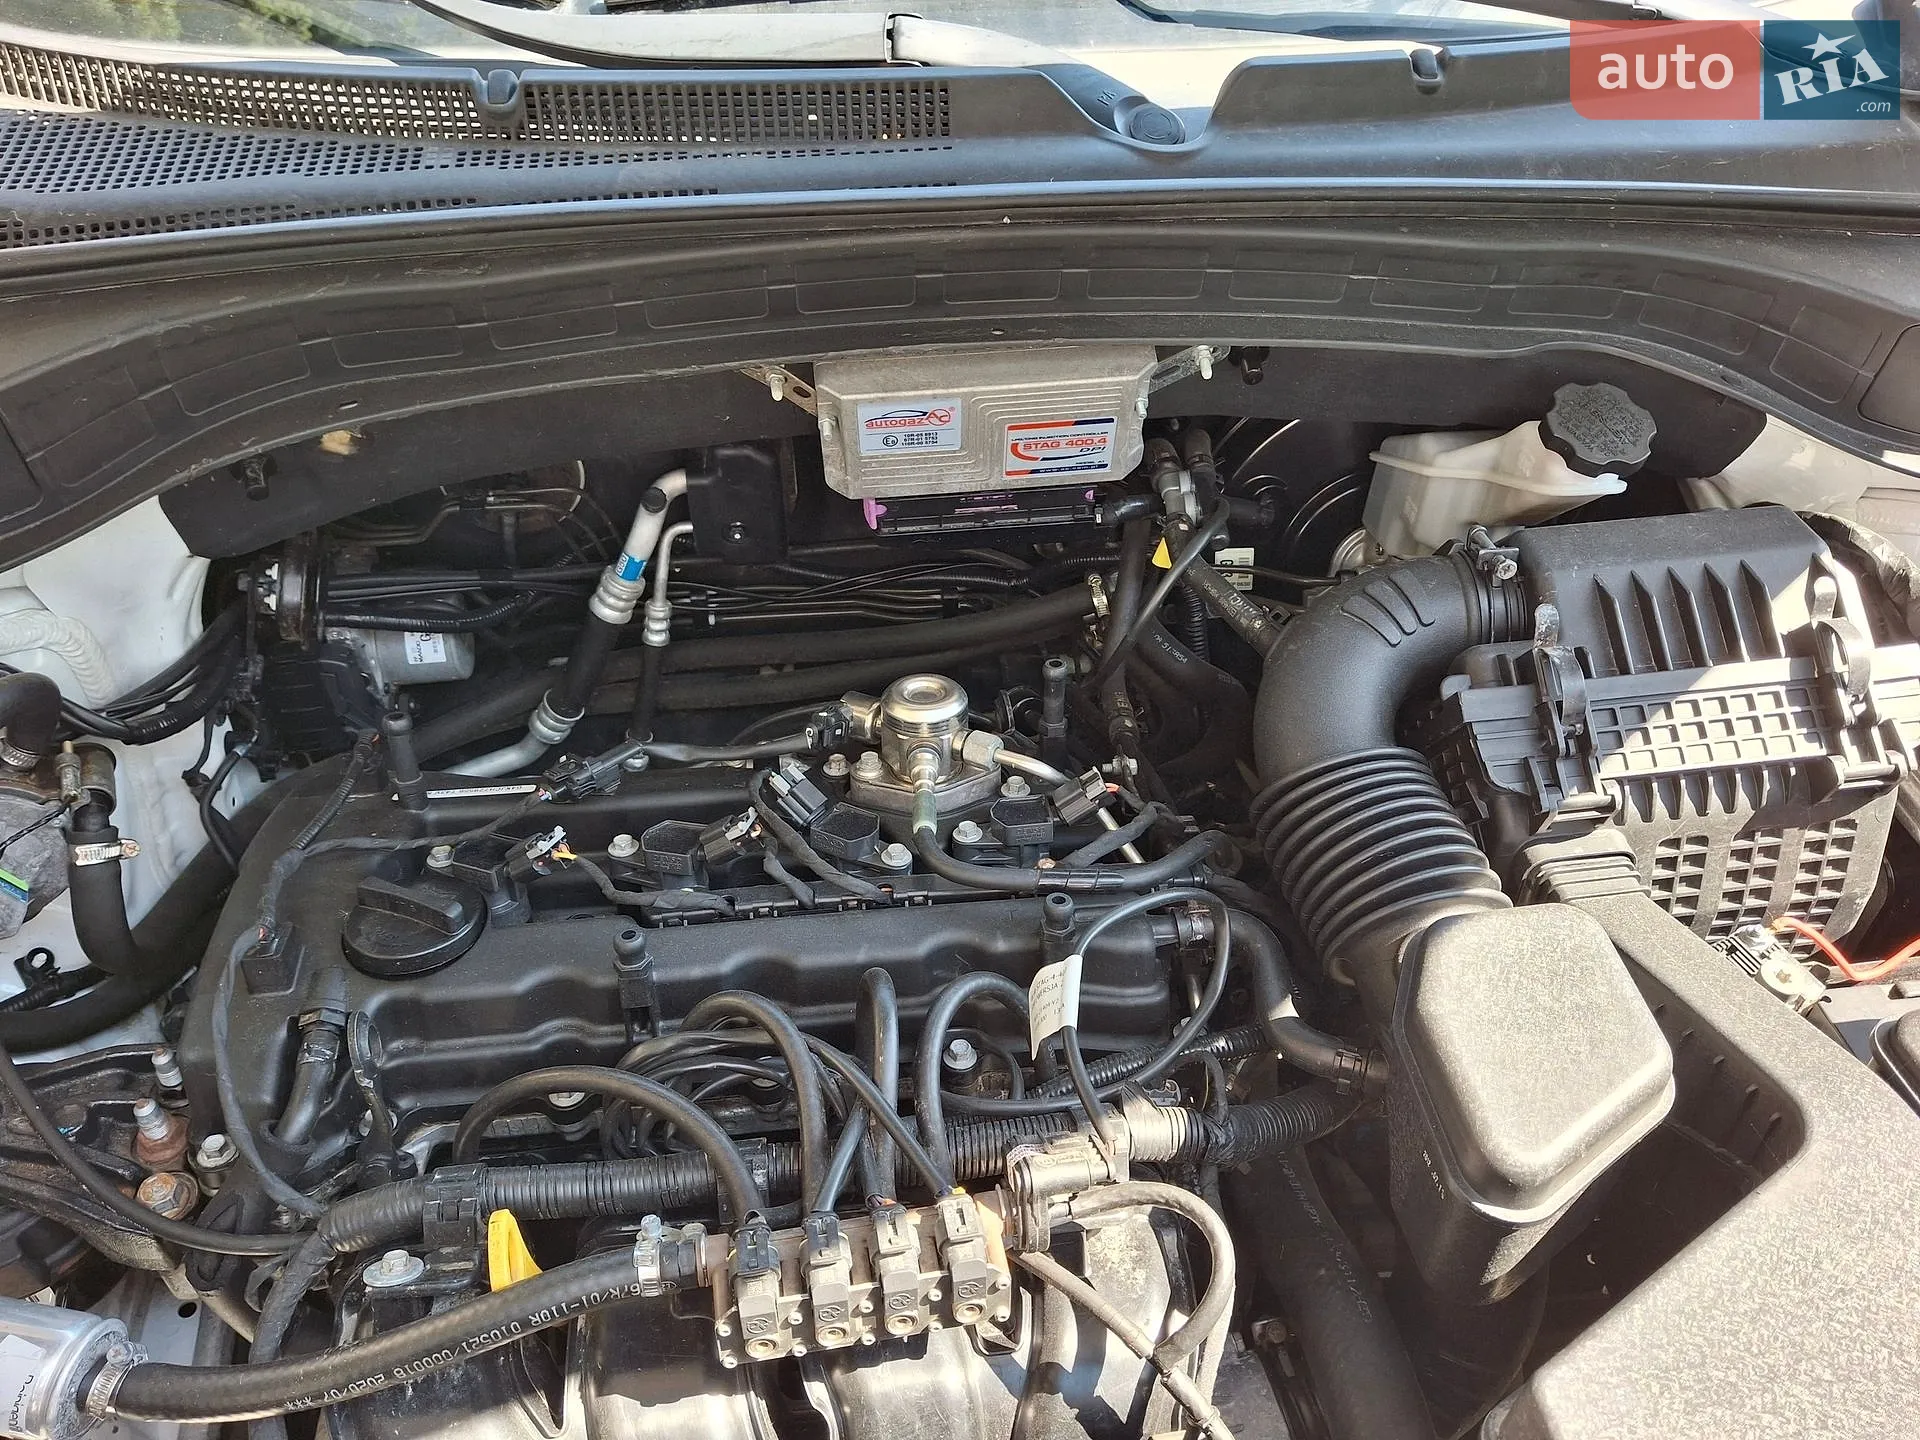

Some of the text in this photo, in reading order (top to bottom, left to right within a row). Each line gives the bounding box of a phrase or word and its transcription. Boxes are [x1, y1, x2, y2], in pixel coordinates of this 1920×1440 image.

[865, 417, 926, 427] autogaz
[1023, 437, 1107, 451] STAG 400.4
[323, 1374, 385, 1403] 2020/07
